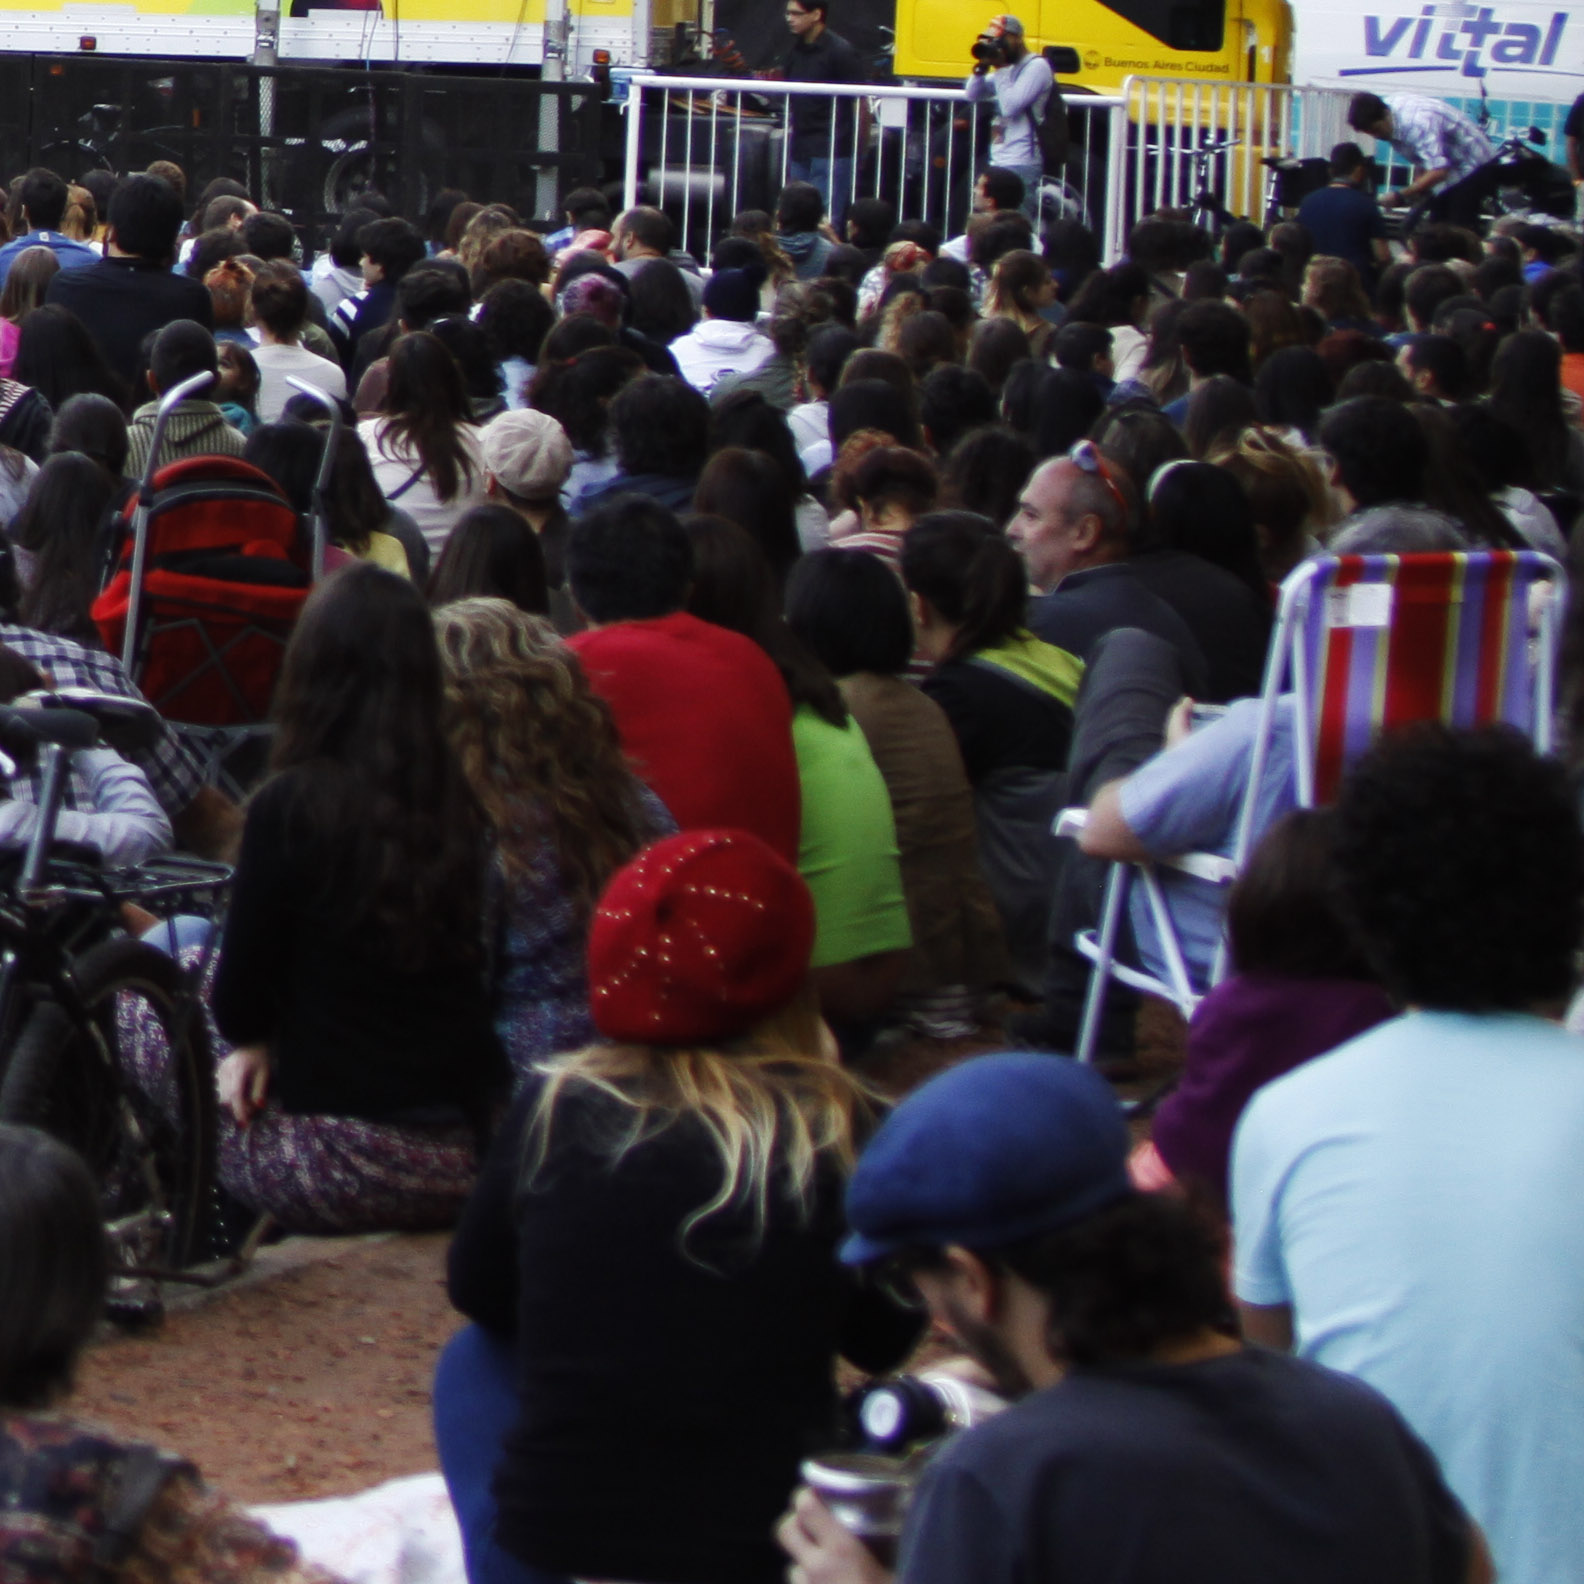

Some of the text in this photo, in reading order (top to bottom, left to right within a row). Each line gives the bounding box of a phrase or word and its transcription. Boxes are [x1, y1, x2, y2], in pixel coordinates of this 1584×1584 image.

[1104, 57, 1230, 74] Buenos Aires Ciudad
